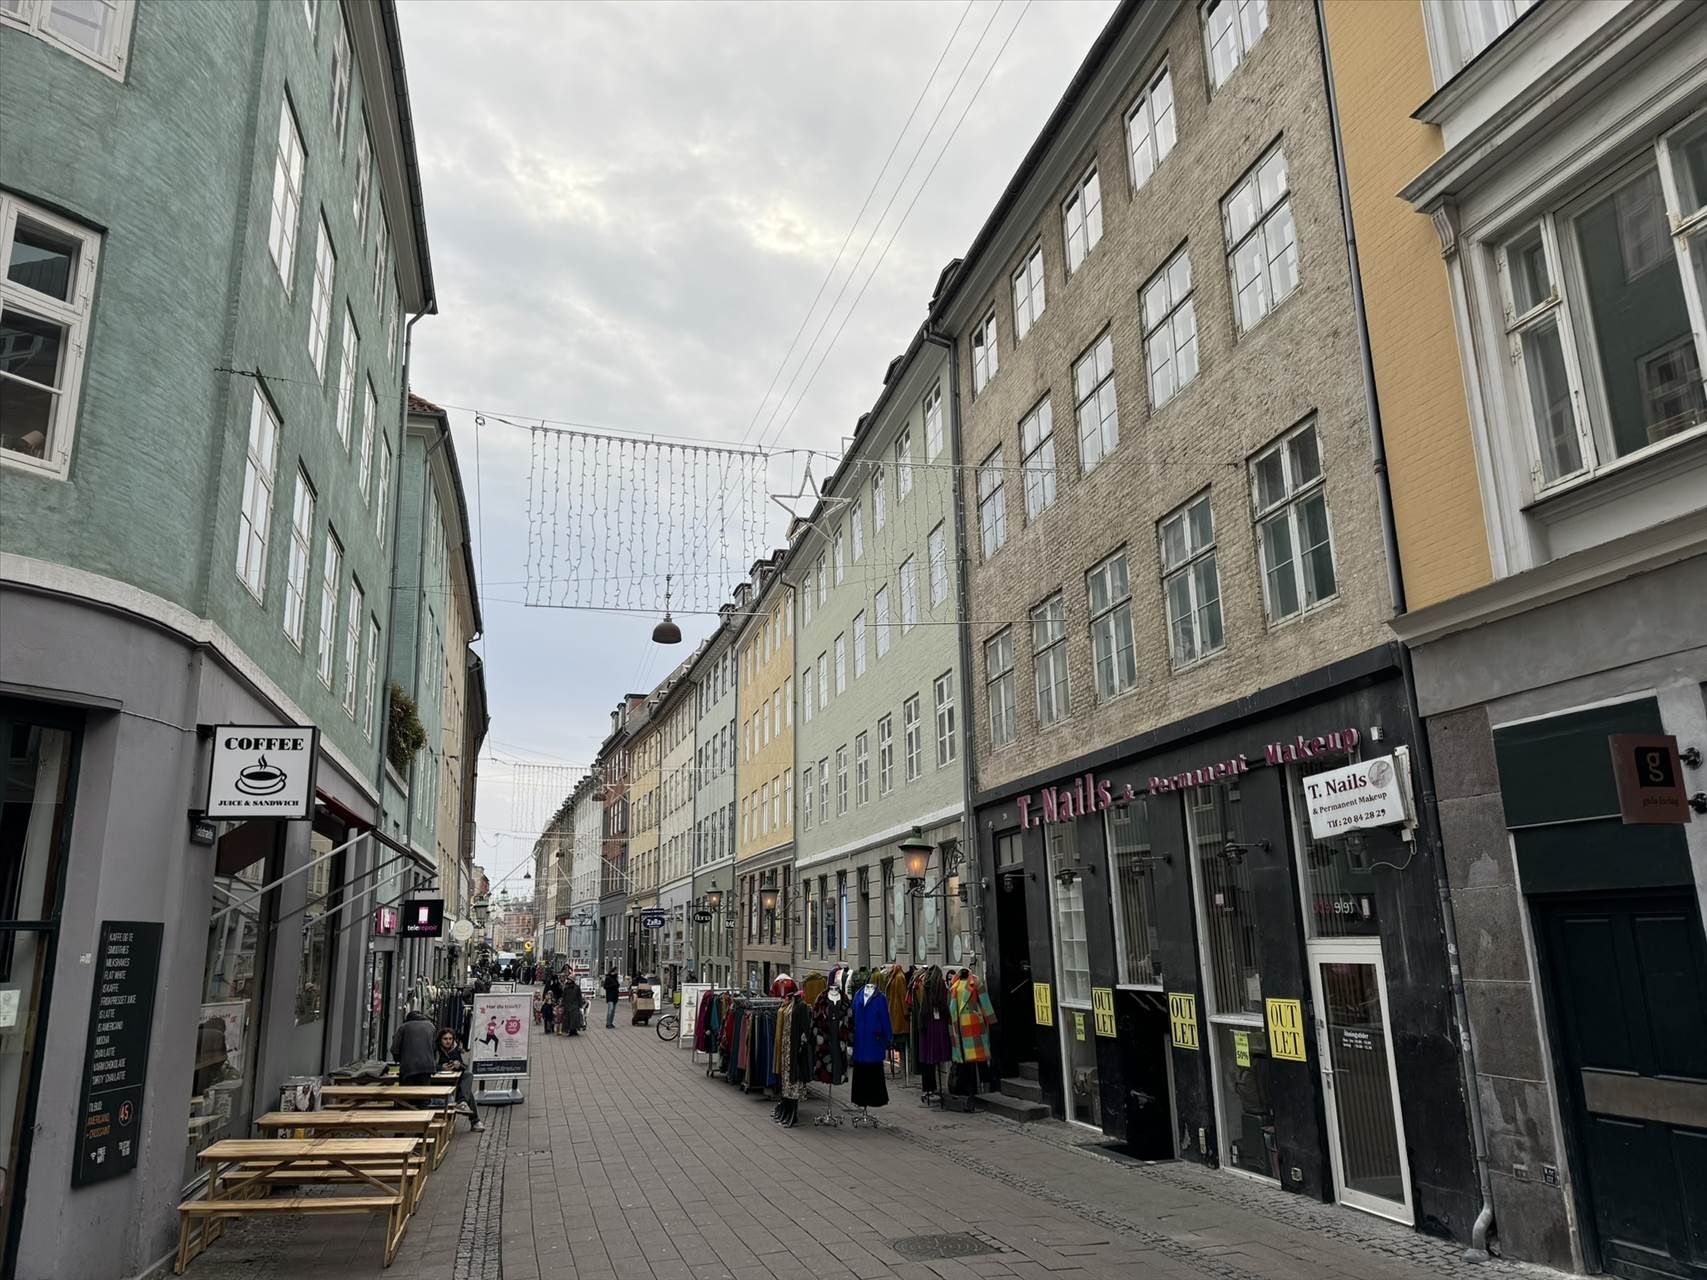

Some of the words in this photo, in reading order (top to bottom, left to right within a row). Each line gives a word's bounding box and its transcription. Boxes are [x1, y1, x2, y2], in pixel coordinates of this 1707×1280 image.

[225, 738, 304, 750] COFFEE
[1123, 784, 1135, 801] &
[1147, 753, 1249, 795] Permanent
[1265, 728, 1358, 766] Makeup
[1646, 752, 1664, 782] g
[1308, 784, 1322, 799] T.
[1326, 774, 1367, 796] Nails
[1320, 799, 1357, 813] Permanent
[1360, 792, 1387, 804] Makeup
[1343, 817, 1352, 825] 20
[1036, 986, 1049, 1003] OUT
[1094, 992, 1111, 1010] OUT
[1037, 1005, 1049, 1022] LET
[1171, 997, 1193, 1019] OUT
[1271, 1004, 1296, 1028] OUT
[1096, 1014, 1113, 1033] LET
[1173, 1022, 1196, 1045] LET
[1273, 1031, 1299, 1055] LET
[121, 1104, 129, 1121] 45
